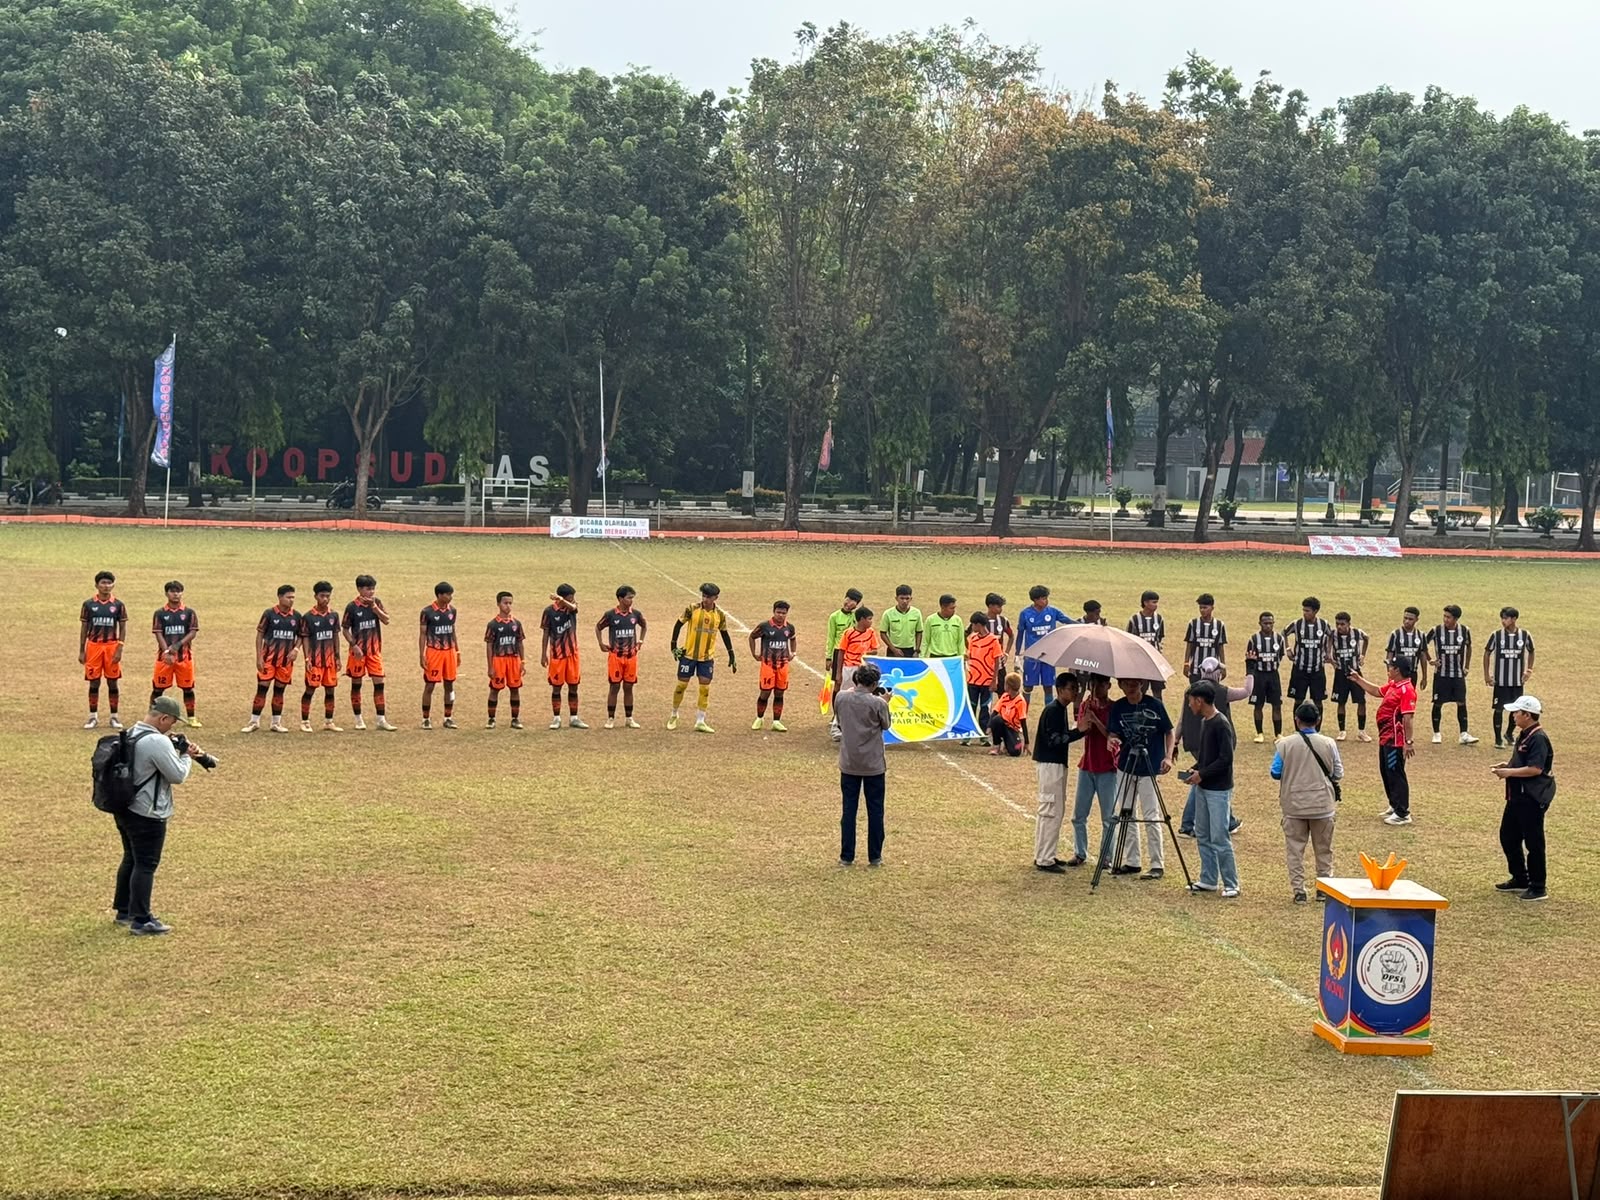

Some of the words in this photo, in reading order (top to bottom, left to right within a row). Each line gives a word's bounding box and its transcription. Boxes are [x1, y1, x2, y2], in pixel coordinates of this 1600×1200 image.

[1083, 660, 1099, 668] BNI
[158, 676, 167, 684] 12
[763, 677, 771, 685] 14
